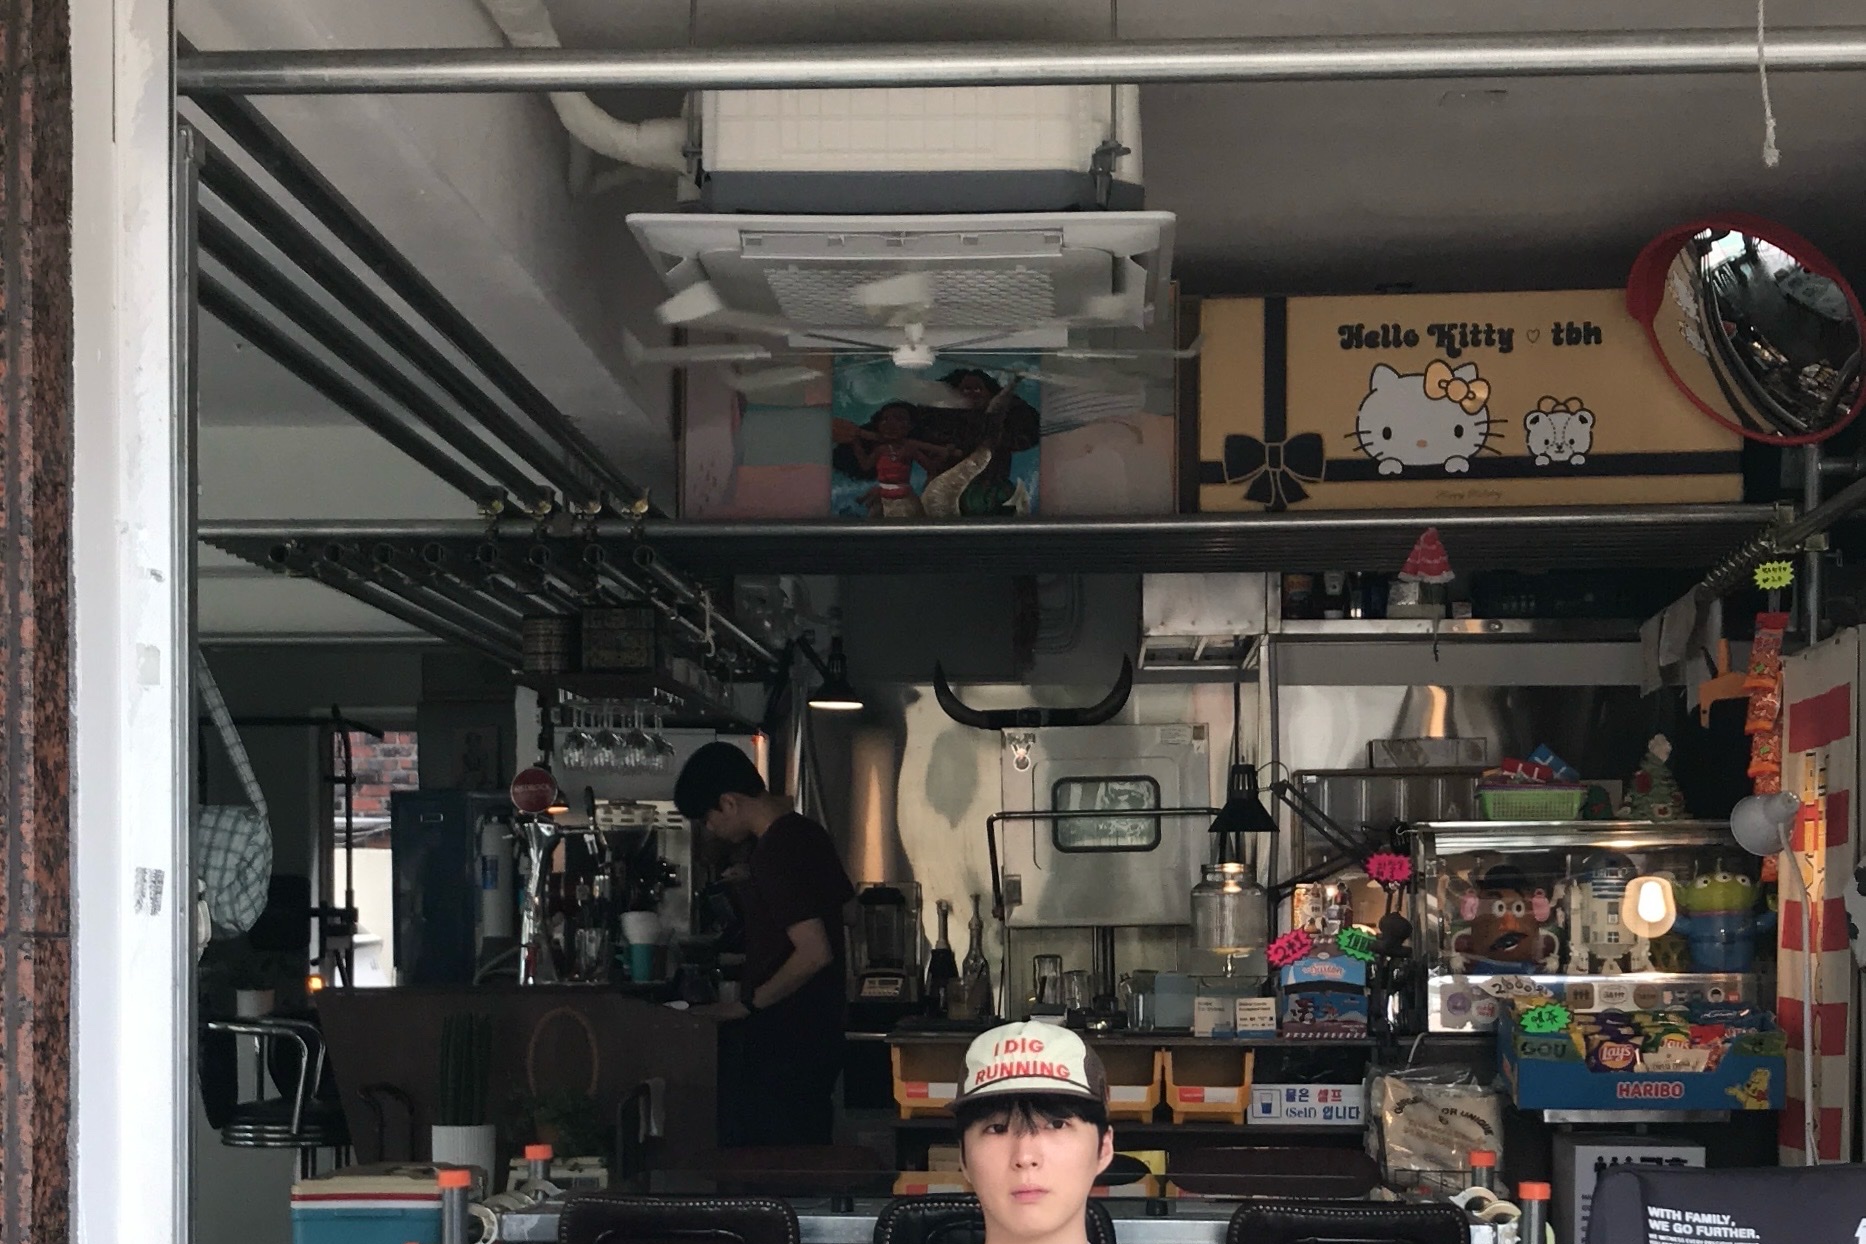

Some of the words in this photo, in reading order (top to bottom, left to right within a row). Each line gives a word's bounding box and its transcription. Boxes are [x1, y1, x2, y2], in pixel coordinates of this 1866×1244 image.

[1338, 323, 1420, 350] Hello
[1427, 323, 1515, 358] Kitty
[1551, 321, 1603, 346] tbh
[994, 1041, 999, 1057] I
[1004, 1038, 1044, 1054] DIG
[975, 1060, 1071, 1085] RUNNING
[1285, 1088, 1309, 1102] 물은
[1317, 1088, 1342, 1103] 셀프
[1617, 1081, 1685, 1099] HARIBO
[1285, 1107, 1317, 1118] (Self)
[1322, 1106, 1360, 1120] 입니다
[1647, 1206, 1682, 1221] WITH
[1685, 1211, 1736, 1227] FAMILY,
[1648, 1219, 1670, 1232] WE
[1672, 1222, 1694, 1235] GO
[1696, 1225, 1761, 1240] FURTHER.
